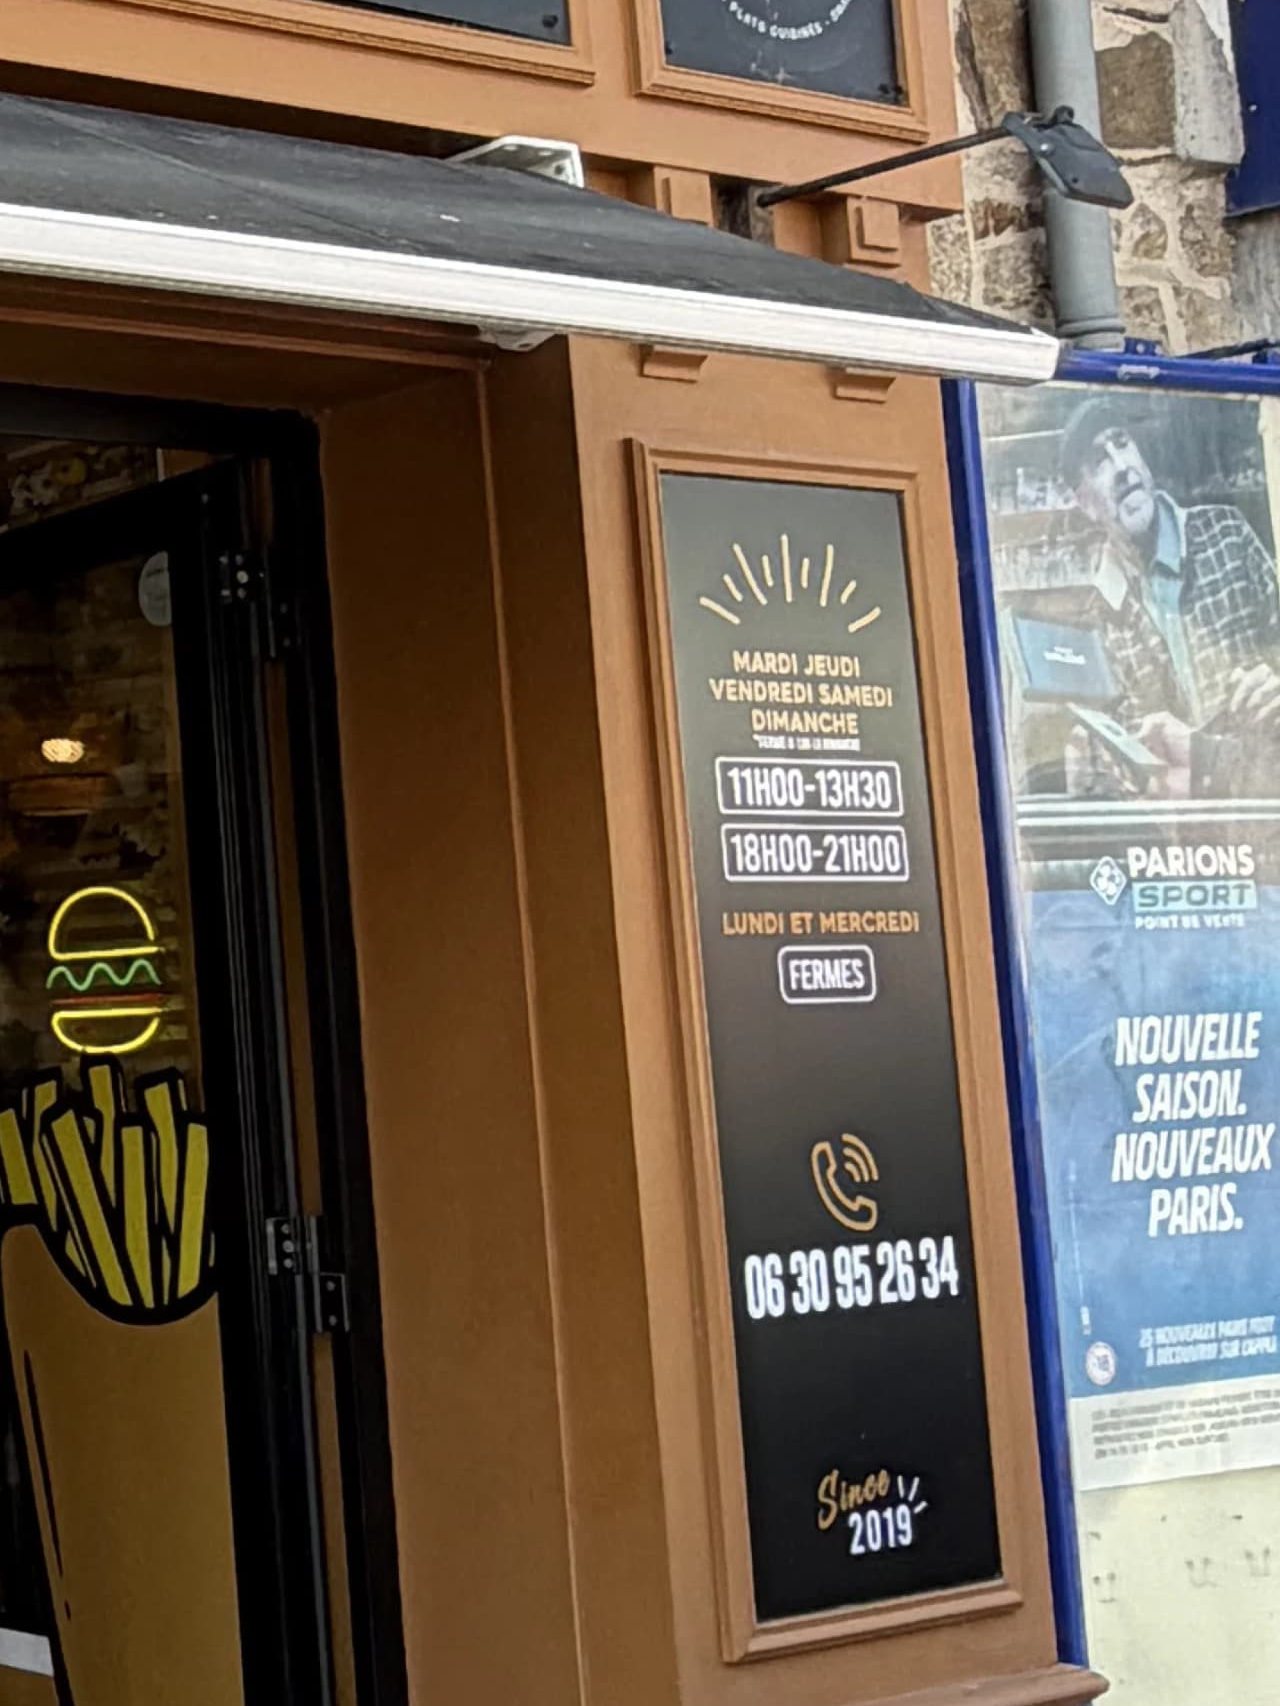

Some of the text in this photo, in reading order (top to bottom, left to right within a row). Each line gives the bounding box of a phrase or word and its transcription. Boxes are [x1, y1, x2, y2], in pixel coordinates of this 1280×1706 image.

[733, 650, 860, 678] MARDI JEUDI
[708, 678, 893, 708] VENDREDI SAMEDI
[751, 709, 858, 734] DIMANCHE
[727, 766, 892, 809] 11H00-13H30
[730, 833, 902, 874] 18H00-21H00
[1127, 844, 1255, 878] PARIONS
[1138, 884, 1251, 908] SPORT
[790, 912, 813, 934] ET
[789, 958, 865, 991] FERMES
[1114, 1011, 1263, 1066] NOUVELLE
[1132, 1068, 1247, 1123] SAISON.
[1111, 1122, 1276, 1182] NOUVEAUX
[1148, 1182, 1244, 1237] PARIS.
[744, 1235, 959, 1320] 06 30 95 26 34
[817, 1468, 890, 1530] Since
[847, 1503, 912, 1556] 2019
